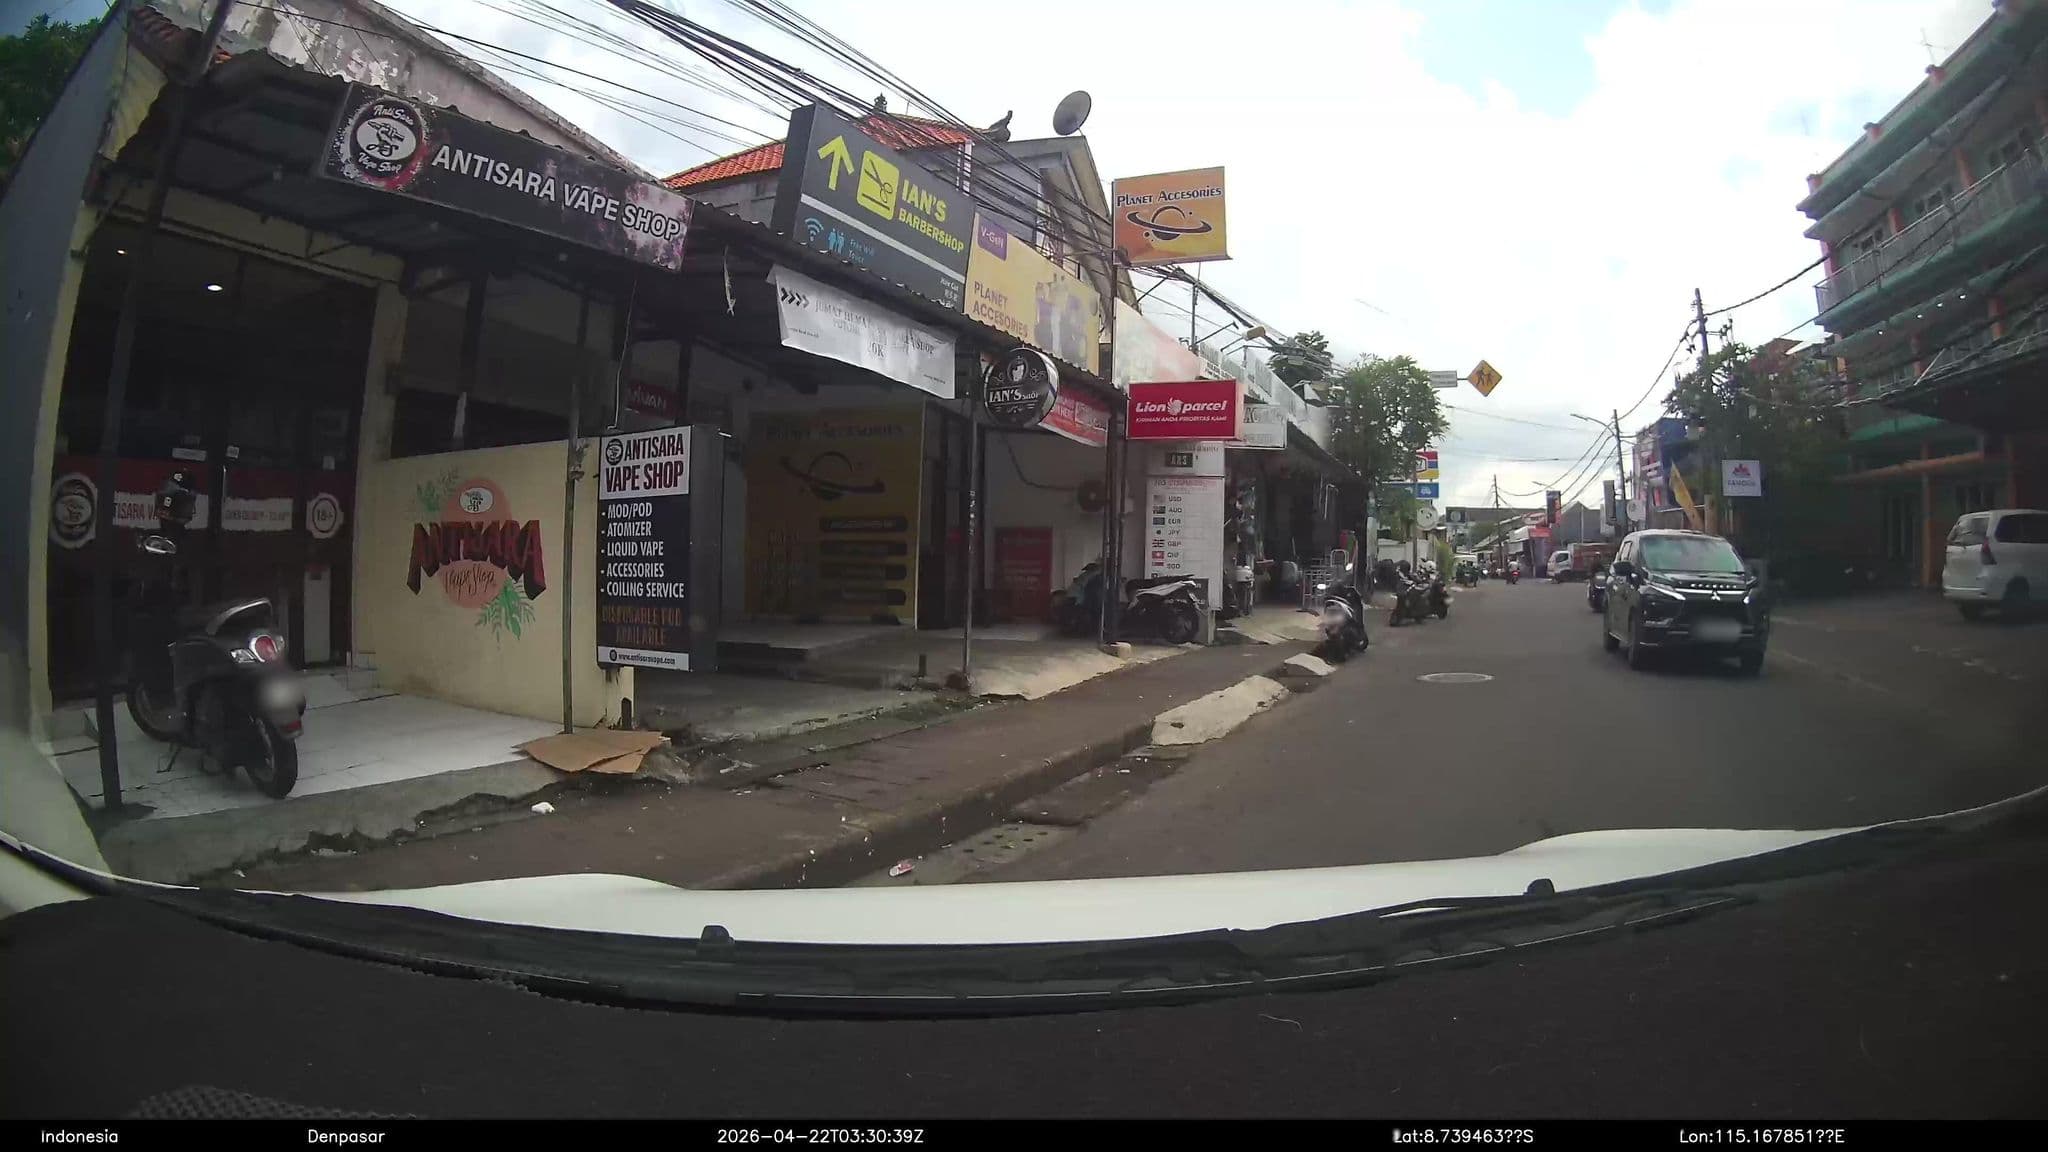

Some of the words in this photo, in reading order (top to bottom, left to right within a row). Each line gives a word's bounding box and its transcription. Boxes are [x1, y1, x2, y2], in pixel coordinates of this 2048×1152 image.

[431, 145, 556, 202] ANTISARA
[562, 183, 620, 221] VAPE
[621, 203, 681, 240] SHOP
[901, 179, 947, 222] IAN'S
[898, 207, 964, 253] BARBERSHOP
[974, 281, 1008, 307] PLANET
[972, 300, 1029, 339] ACCESORIES
[988, 388, 1021, 403] IAN'S
[1136, 402, 1166, 412] Lion
[1182, 400, 1227, 414] parcel
[624, 433, 684, 461] ANTISARA
[606, 465, 640, 492] VAPE
[643, 461, 684, 490] SHOP
[608, 502, 653, 519] MOD/POD
[607, 521, 652, 537] ATOMIZER
[607, 541, 638, 557] LIQUID
[640, 541, 664, 556] VAPE
[606, 562, 665, 578] ACCESSORIES
[606, 581, 644, 597] COILING
[646, 582, 684, 598] SERVICE
